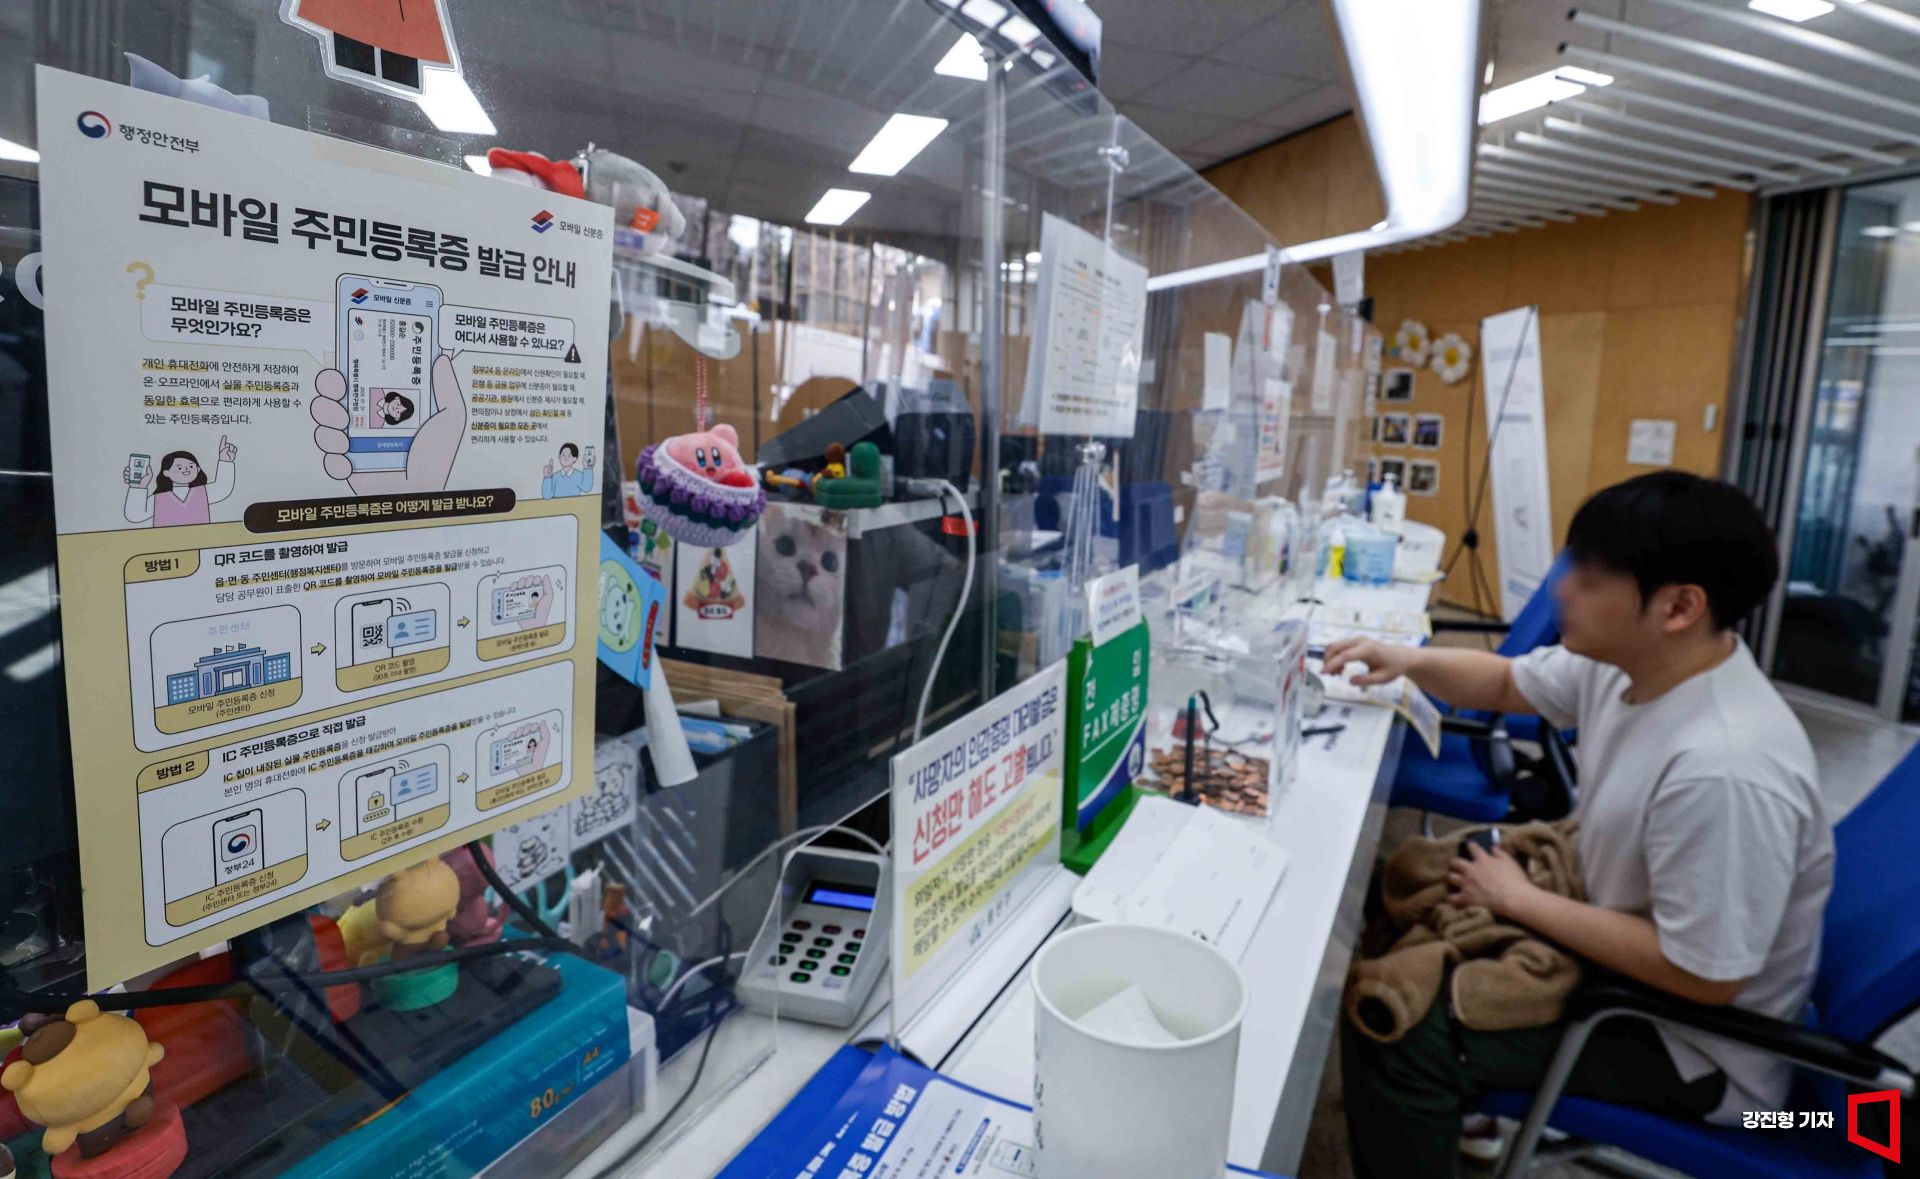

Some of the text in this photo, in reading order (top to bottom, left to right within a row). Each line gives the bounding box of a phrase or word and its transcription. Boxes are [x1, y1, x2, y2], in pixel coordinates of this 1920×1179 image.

[119, 123, 199, 153] 행정안전부
[139, 180, 577, 289] 모바일 주민등록증 발급 안내
[559, 220, 603, 240] 모바일 신분증
[126, 261, 155, 300] ?
[171, 296, 312, 323] 모바일 주민등록증은
[373, 293, 412, 307] 모바일 신분증
[171, 317, 262, 338] 무엇인가요?
[455, 314, 546, 335] 모바일 주민등록증은
[455, 330, 565, 351] 어디서 사용할 수 있나요?
[142, 357, 299, 375] 개인 휴대전화에 안전하게 저장하여
[411, 336, 422, 385] 주민등록증
[472, 365, 494, 375] 정부24
[495, 367, 501, 375] 등
[502, 367, 533, 376] 온라인에서
[143, 376, 300, 392] 온·오프라인에서 실물 주민등록증과
[472, 380, 485, 389] 은행
[487, 380, 493, 389] 등
[528, 382, 551, 391] 신분증이
[143, 395, 302, 409] 동일한 효력으로 편리하게 사용할 수
[471, 407, 503, 417] 편의점이나
[504, 408, 528, 417] 상점에서
[144, 413, 252, 425] 있는 주민등록증입니다.
[471, 421, 497, 431] 신분증이
[471, 435, 497, 444] 편리하게
[517, 436, 523, 444] 수
[277, 495, 494, 523] 모바일 주민등록증은 어떻게 발급 받나요?
[214, 540, 348, 567] QR 코드를 촬영하여 발급
[351, 558, 381, 572] 방문하여
[383, 555, 405, 566] 모바일
[407, 551, 441, 563] 주민등록증
[144, 557, 180, 573] 방법 1
[215, 591, 235, 603] 담당
[237, 587, 273, 601] 공무원이
[275, 584, 301, 594] 표출한
[303, 580, 317, 591] QR
[319, 577, 342, 589] 코드를
[345, 573, 375, 585] 촬영하여
[376, 570, 399, 581] 모바일
[401, 564, 442, 577] 주민등록증을
[208, 621, 250, 636] 주민센터
[374, 664, 386, 673] QR
[388, 661, 401, 670] 코드
[188, 687, 276, 715] 모바일 주민등록증 신청
[216, 705, 251, 719] (주민센터)
[968, 714, 1011, 770] 인감증명
[1012, 685, 1058, 738] 대리발급은
[222, 715, 366, 763] IC 주민등록증으로 직접 발급
[156, 760, 195, 780] 방법 2
[223, 772, 234, 783] IC
[236, 767, 254, 781] 칩이
[256, 759, 282, 773] 내장된
[284, 754, 300, 766] 실물
[302, 741, 348, 761] 주민등록증을
[224, 785, 242, 798] 본인
[245, 778, 262, 791] 명의
[264, 768, 306, 787] 휴대전화에
[308, 762, 317, 773] IC
[318, 748, 364, 769] 주민등록증을
[396, 734, 417, 746] 모바일
[912, 788, 964, 866] 신청만
[968, 764, 997, 820] 해도
[224, 857, 255, 875] 정부24
[205, 870, 275, 903] IC 주민등록증 신청
